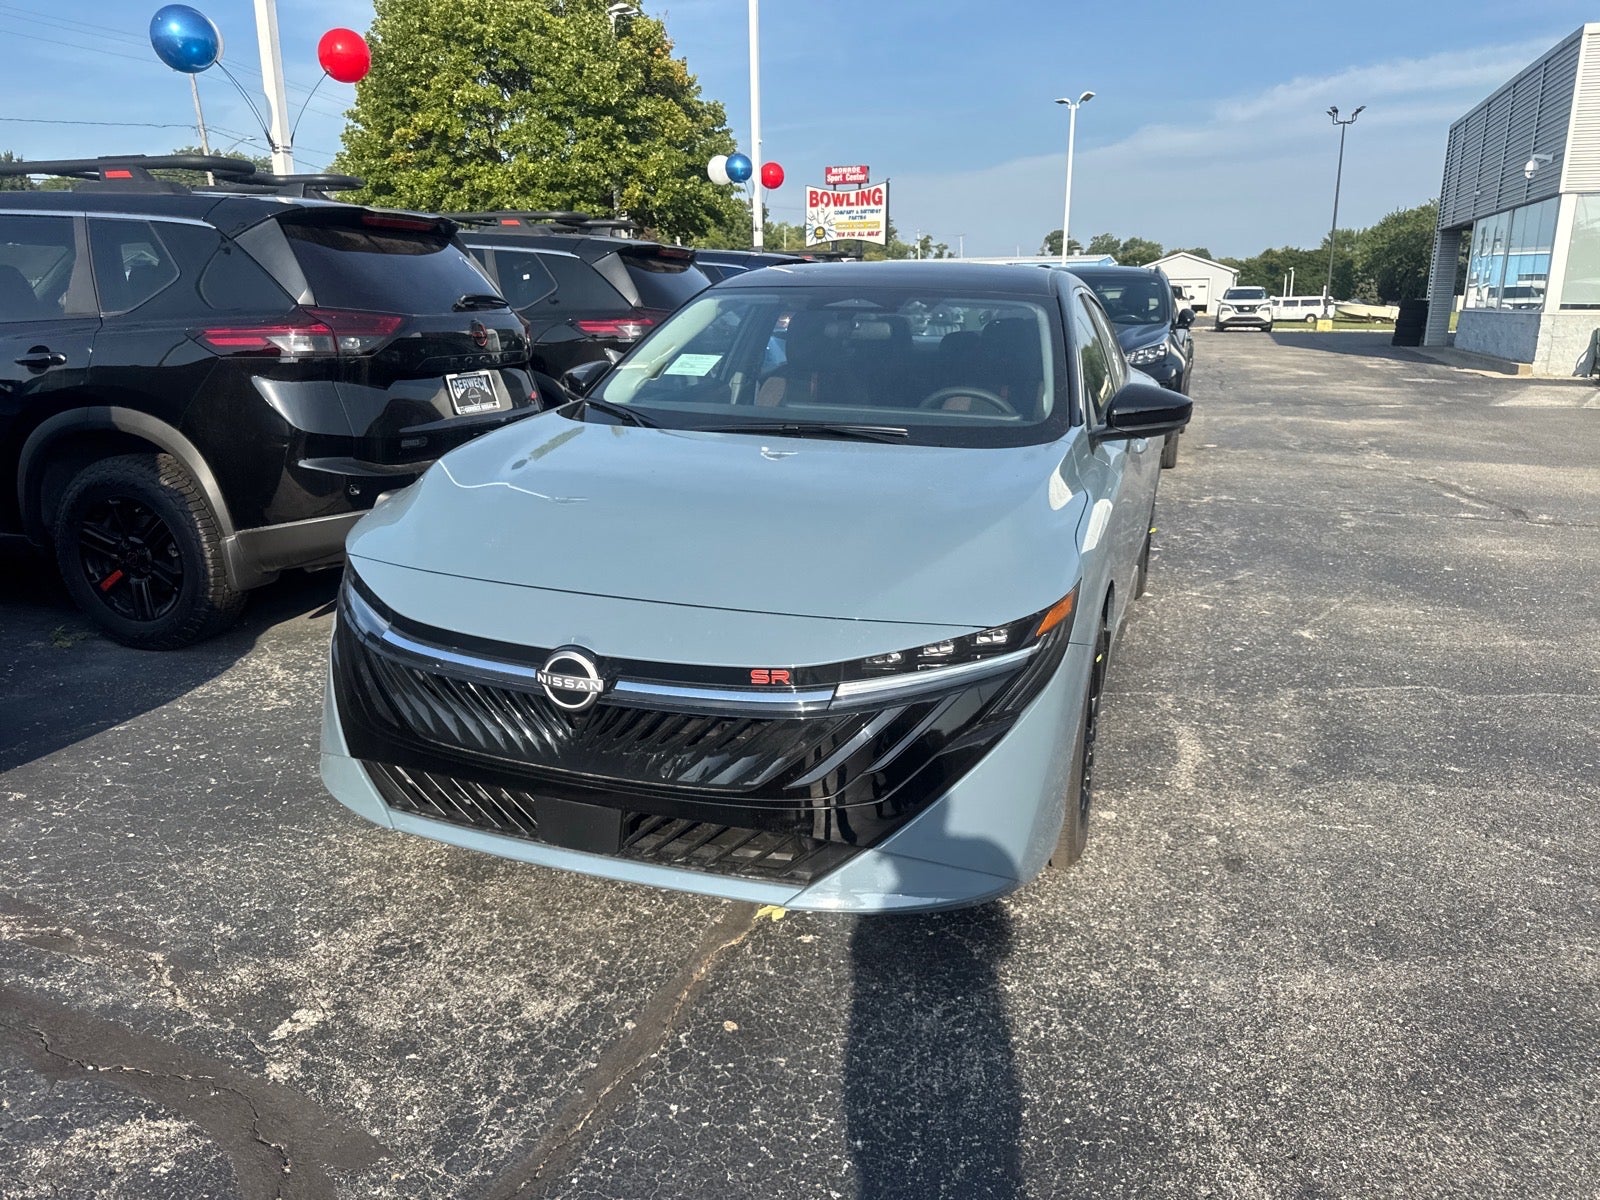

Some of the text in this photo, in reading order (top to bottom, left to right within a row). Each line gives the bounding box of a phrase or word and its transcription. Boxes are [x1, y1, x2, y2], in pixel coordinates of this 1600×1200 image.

[827, 173, 866, 183] Sport Center
[832, 166, 861, 174] MONROE
[809, 187, 883, 208] BOWLING
[452, 376, 492, 400] GERWECK
[537, 672, 603, 691] NISSAN
[750, 669, 791, 684] SR
